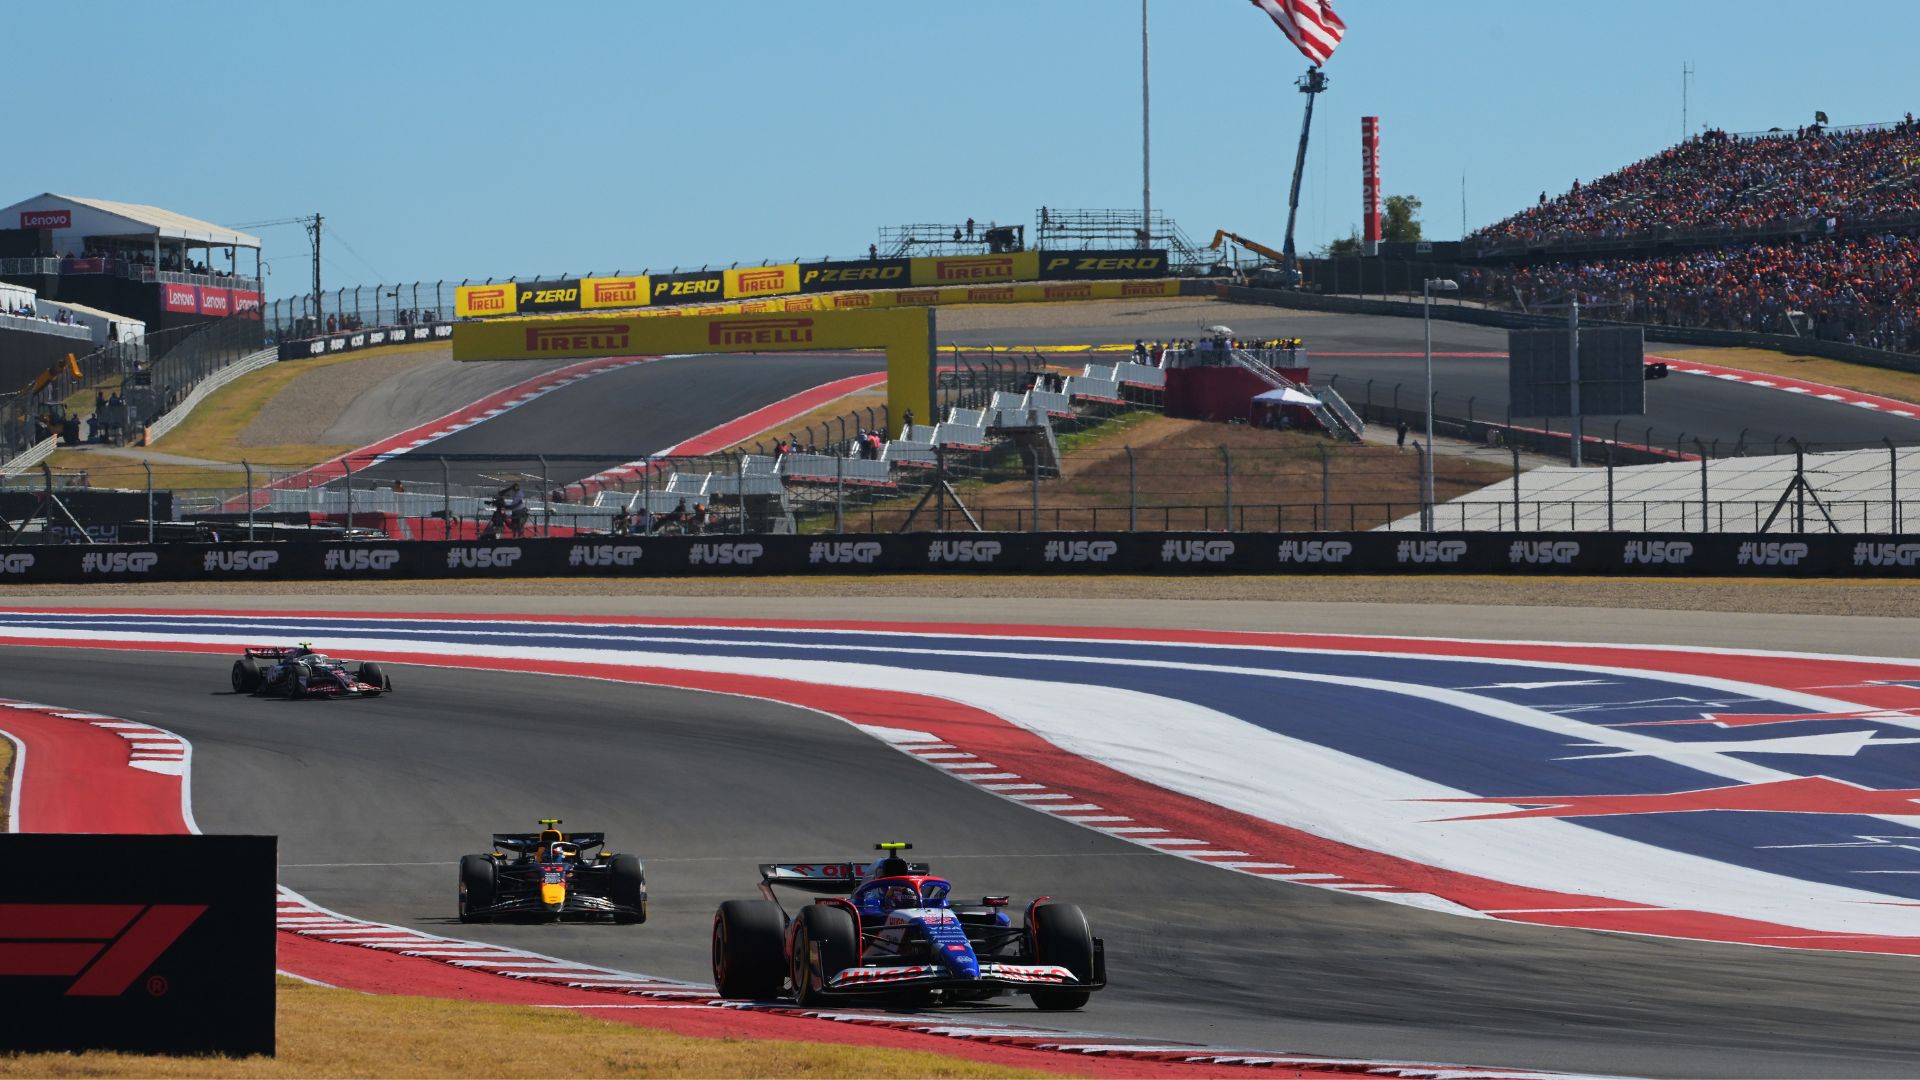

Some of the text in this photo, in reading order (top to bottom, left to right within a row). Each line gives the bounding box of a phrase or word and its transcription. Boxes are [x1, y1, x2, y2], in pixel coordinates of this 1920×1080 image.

[24, 215, 67, 226] Lenovo
[804, 266, 903, 284] P ZERO
[936, 258, 1013, 279] PIRELLI
[1046, 257, 1160, 271] P ZERO
[594, 281, 636, 303] PIRELLI
[654, 279, 720, 296] P ZERO
[738, 270, 785, 293] PIRELLI
[169, 288, 195, 306] Lenovo
[202, 292, 226, 309] Lenovo
[467, 289, 505, 311] PIRELLI
[520, 288, 578, 304] P ZERO
[526, 324, 630, 351] PIRELLI
[710, 317, 814, 345] PIRELLI
[203, 550, 280, 571] #USGP
[324, 548, 400, 570] #USGP
[446, 546, 521, 568] #USGP
[568, 545, 643, 566] #USGP
[688, 543, 764, 564] #USGP
[808, 541, 882, 563] #USGP
[927, 540, 1002, 562] #USGP
[1043, 540, 1118, 562] #USGP
[1161, 540, 1235, 562] #USGP
[1278, 540, 1352, 562] #USGP
[1396, 540, 1467, 562] #USGP
[1508, 541, 1580, 564] #USGP
[1623, 541, 1693, 564] #USGP
[1736, 542, 1808, 565] #USGP
[0, 553, 35, 573] GP
[81, 552, 159, 574] #USGP
